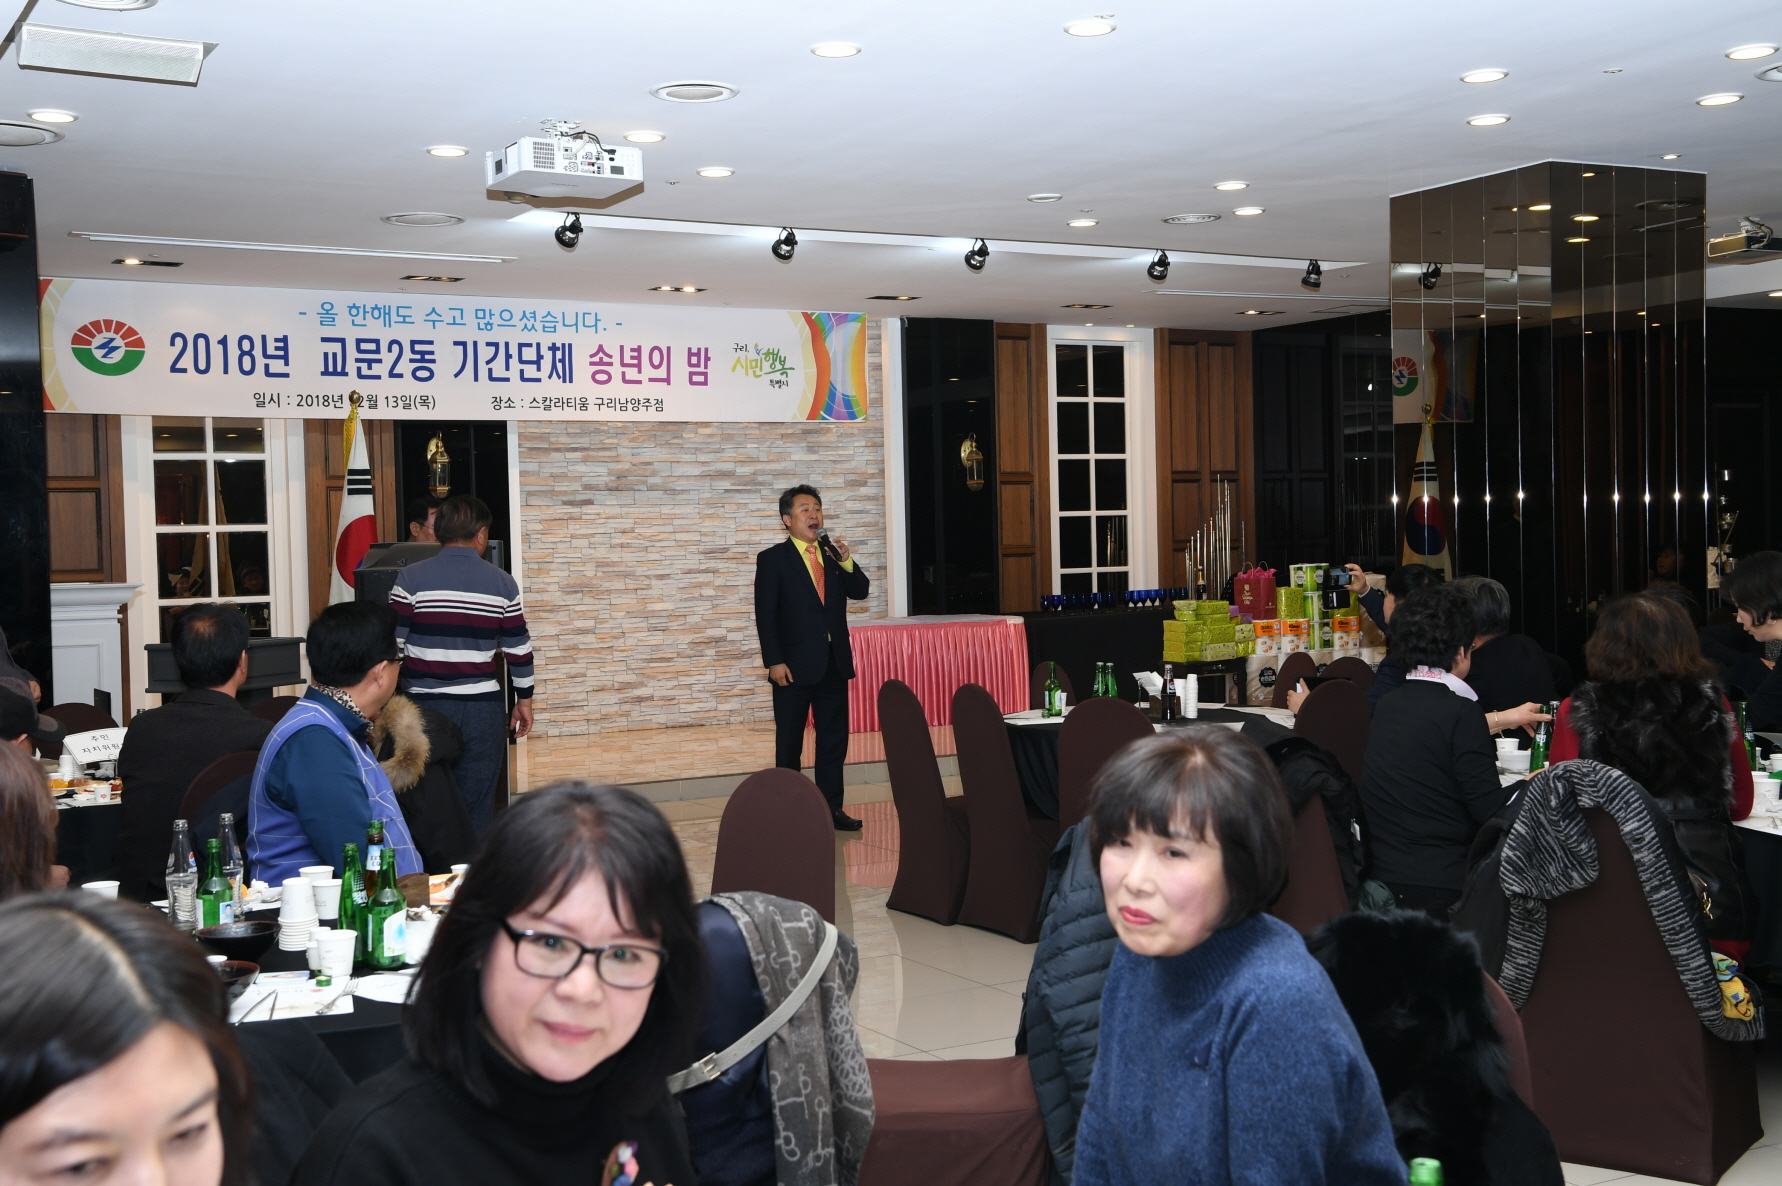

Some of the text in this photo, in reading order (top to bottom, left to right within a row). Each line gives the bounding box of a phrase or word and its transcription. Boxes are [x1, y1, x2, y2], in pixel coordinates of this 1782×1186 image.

[316, 301, 339, 327] 올
[346, 302, 416, 329] 한해도
[423, 306, 467, 330] 수고
[474, 308, 607, 335] 많으셨습니다.
[169, 331, 712, 387] 2018년 교문2동 기간단체 송년의 밤
[252, 391, 281, 409] 일시
[296, 393, 344, 409] 2018년
[384, 394, 436, 411] 13일(목)
[490, 395, 517, 411] 장소
[528, 396, 590, 412] 스칼라티움
[593, 397, 664, 413] 구리남양주점
[91, 734, 109, 742] 주민
[81, 743, 122, 753] 자치위원
